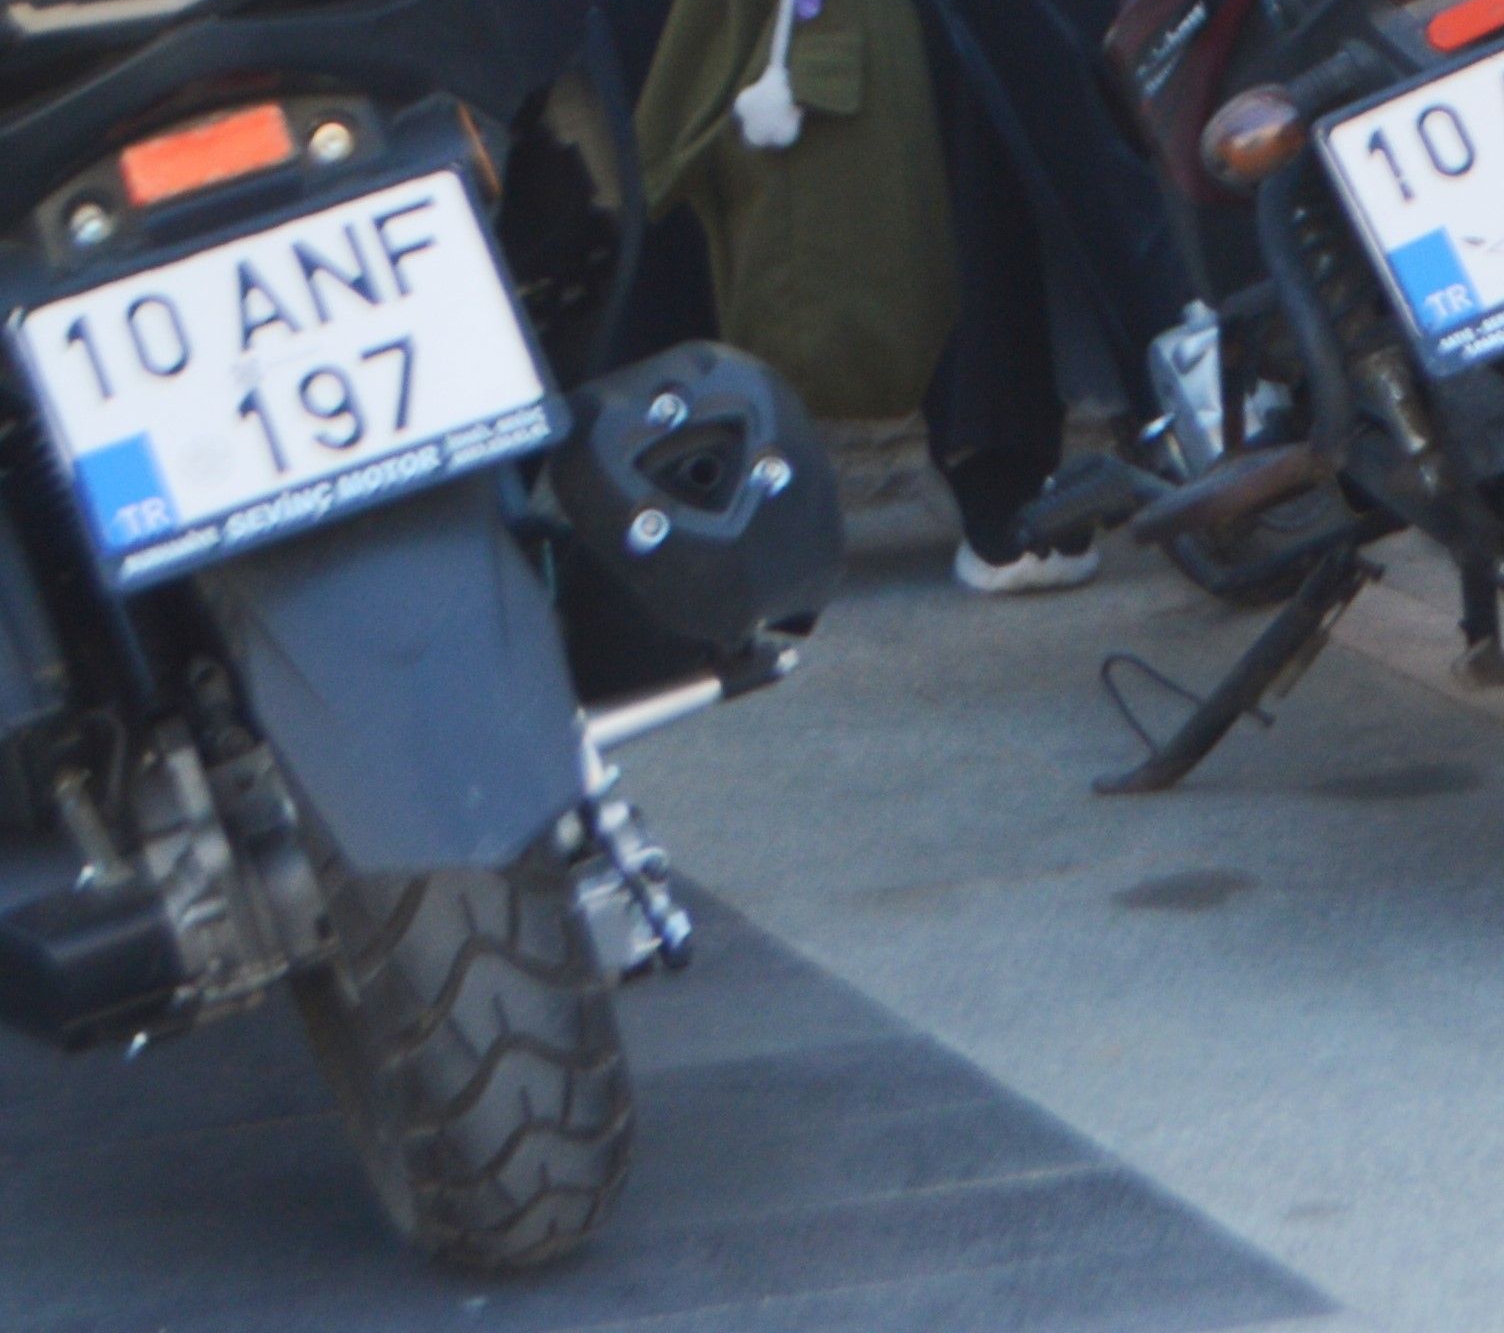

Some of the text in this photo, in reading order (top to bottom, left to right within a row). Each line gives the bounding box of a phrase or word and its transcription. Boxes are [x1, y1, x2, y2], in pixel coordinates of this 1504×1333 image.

[1367, 102, 1477, 203] 10
[65, 197, 437, 402] 10 ANF
[1424, 283, 1474, 323] TR
[238, 333, 417, 475] 197
[335, 442, 442, 505] MOTOR
[114, 496, 169, 539] TR
